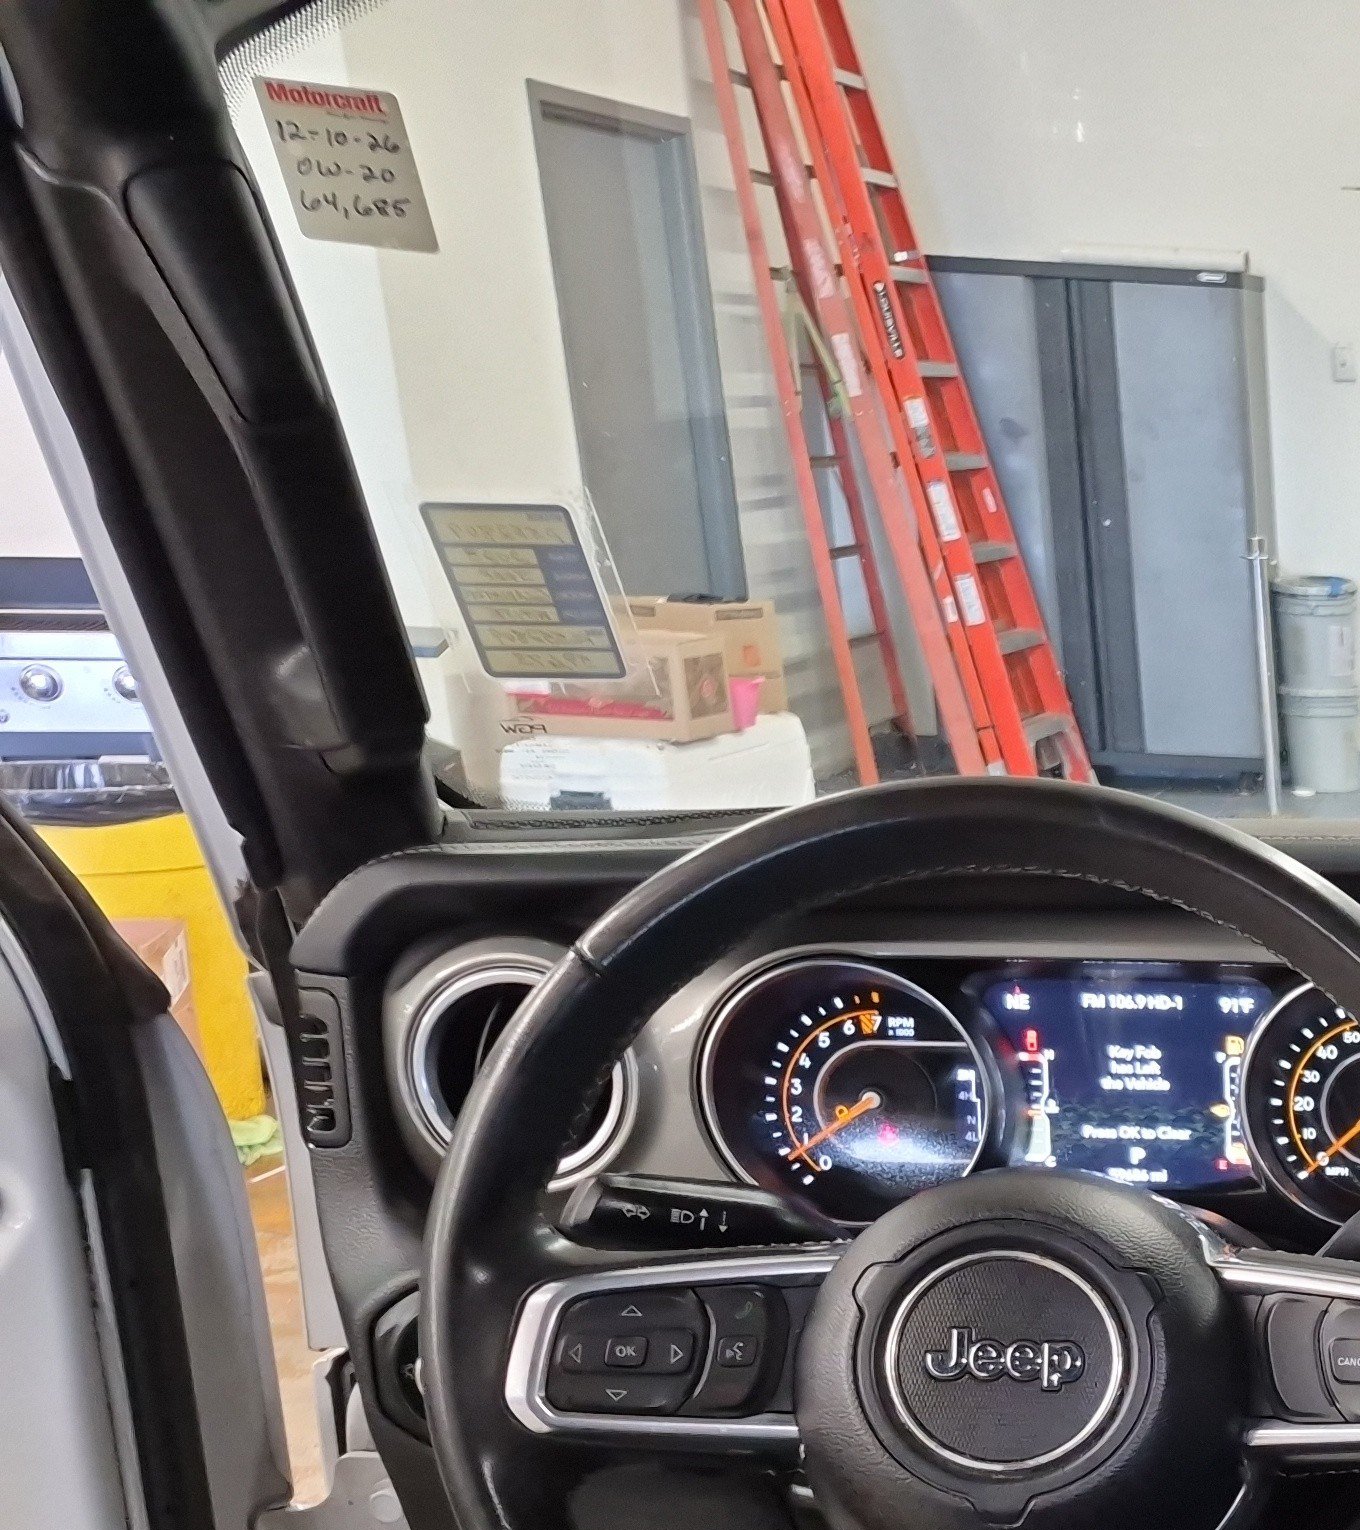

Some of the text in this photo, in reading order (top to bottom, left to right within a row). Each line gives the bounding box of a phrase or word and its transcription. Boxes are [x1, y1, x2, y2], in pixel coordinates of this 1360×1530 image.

[264, 80, 388, 118] Motorcraft
[275, 119, 401, 152] 12-10-26
[843, 1020, 856, 1035] 6
[871, 1016, 882, 1032] 7
[887, 1017, 915, 1028] RPM
[818, 1031, 831, 1048] 5
[1342, 1030, 1360, 1044] 50
[1316, 1044, 1339, 1060] 40
[799, 1053, 812, 1069] 4
[1302, 1070, 1320, 1083] 30
[791, 1078, 803, 1095] 3
[1293, 1096, 1315, 1112] 20
[791, 1106, 803, 1122] 2
[1302, 1127, 1317, 1140] 10
[819, 1155, 832, 1171] 0
[1129, 1147, 1146, 1165] P
[615, 1345, 637, 1358] OK
[925, 1326, 1086, 1392] Jeep
